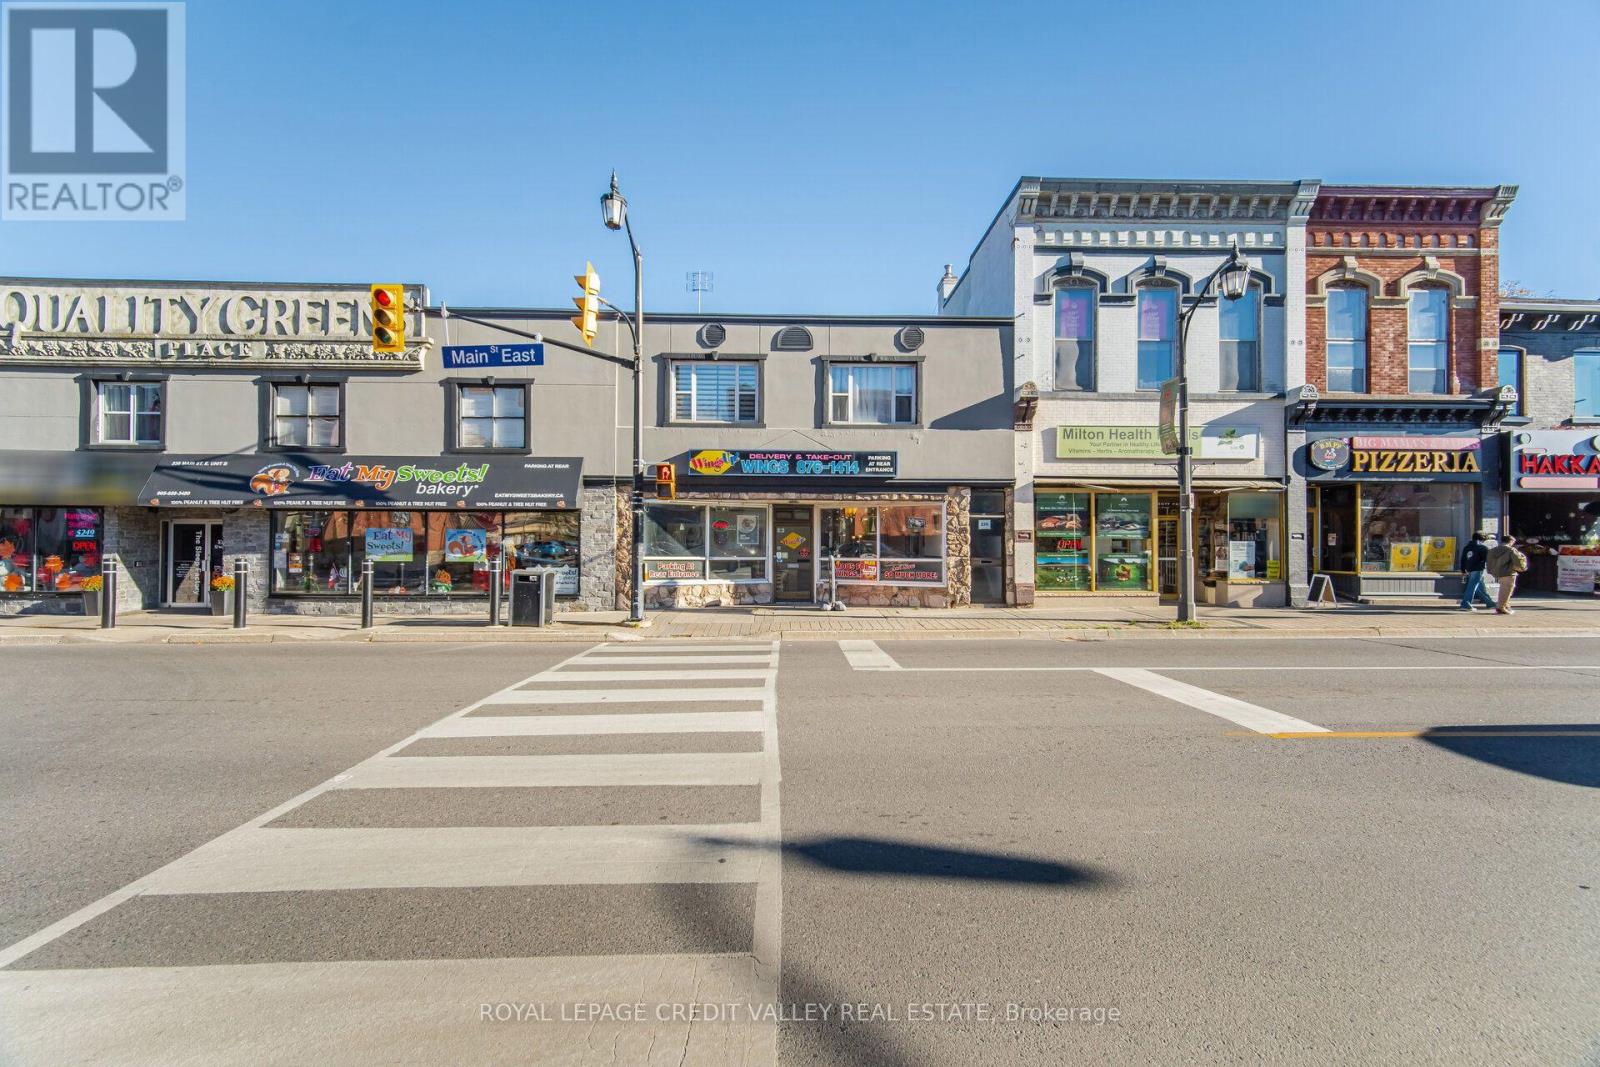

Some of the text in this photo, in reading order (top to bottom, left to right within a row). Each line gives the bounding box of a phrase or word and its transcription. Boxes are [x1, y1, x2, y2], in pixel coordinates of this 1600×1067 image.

[0, 291, 215, 345] QUALITY
[167, 341, 252, 358] PLACE
[451, 345, 536, 364] Main St East
[1062, 428, 1104, 440] Milton
[1109, 428, 1152, 440] Health
[1357, 438, 1377, 447] BIG
[740, 460, 859, 475] WINGS 876-1414
[1352, 450, 1481, 472] PIZZERIA
[1520, 454, 1600, 474] HAKKA
[304, 461, 354, 482] Eat
[351, 464, 396, 491] My
[395, 462, 490, 483] Sweets!
[195, 529, 203, 544] The
[373, 530, 393, 541] Eat
[72, 541, 97, 551] OPEN
[366, 541, 404, 551] Sweets!
[1057, 539, 1083, 550] OPEN
[194, 546, 202, 566] Sleep
[656, 562, 685, 571] Parking
